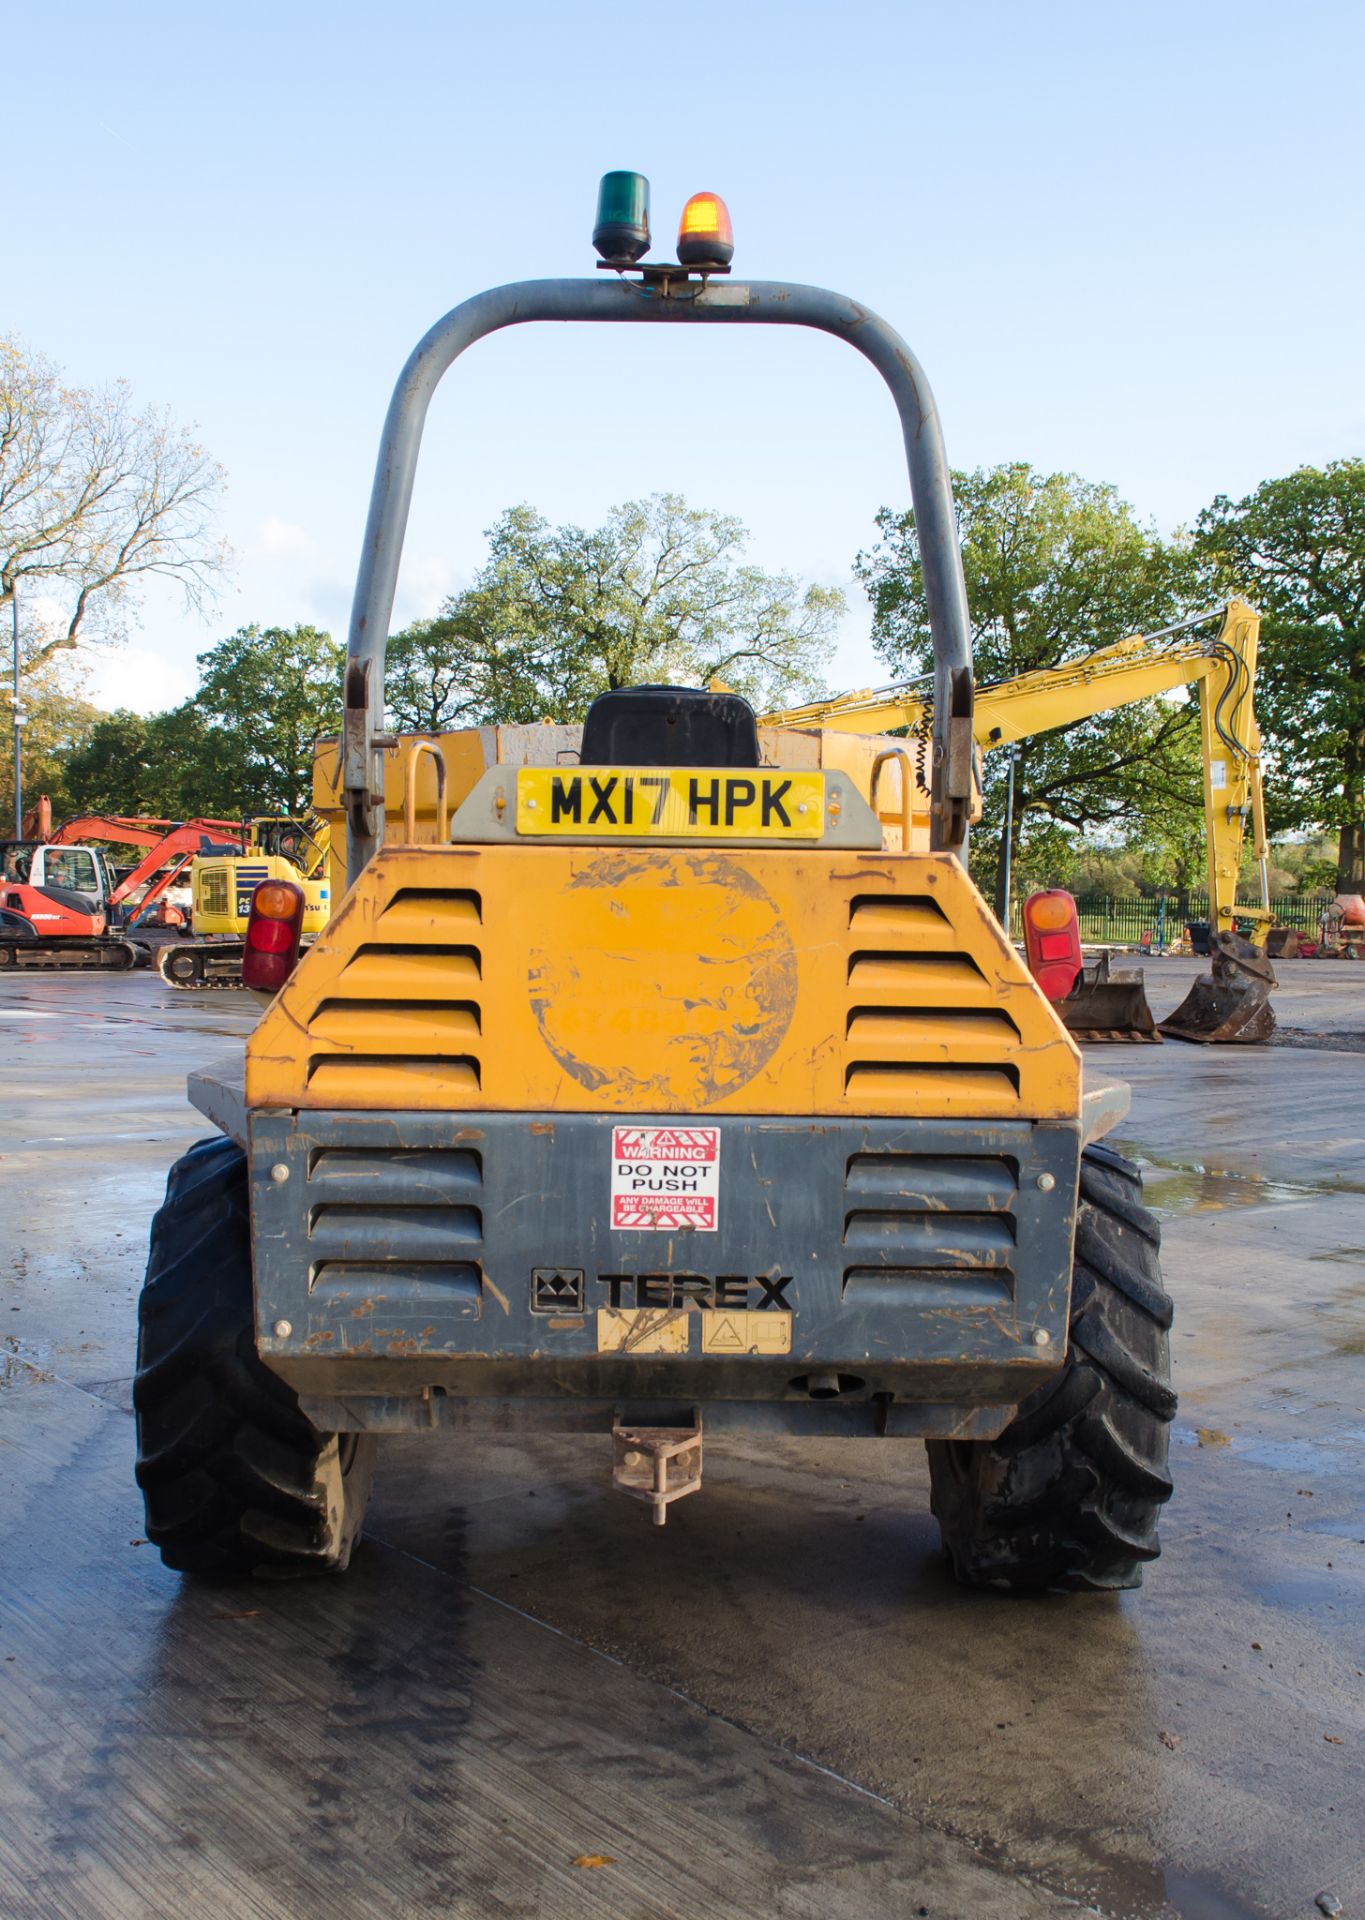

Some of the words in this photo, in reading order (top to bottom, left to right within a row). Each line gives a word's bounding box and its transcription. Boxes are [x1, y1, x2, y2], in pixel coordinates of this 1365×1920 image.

[551, 776, 670, 825] MX17
[688, 778, 792, 827] HPK
[622, 1146, 706, 1160] WARNING
[618, 1164, 652, 1176] DO
[663, 1165, 712, 1178] NOT
[632, 1179, 697, 1191] PUSH
[619, 1196, 640, 1204] ANY
[641, 1197, 685, 1206] DAMAGE
[686, 1198, 709, 1206] WILL
[623, 1204, 637, 1212] BE
[638, 1204, 704, 1213] CHARGEABLE
[598, 1274, 794, 1309] TEREX
